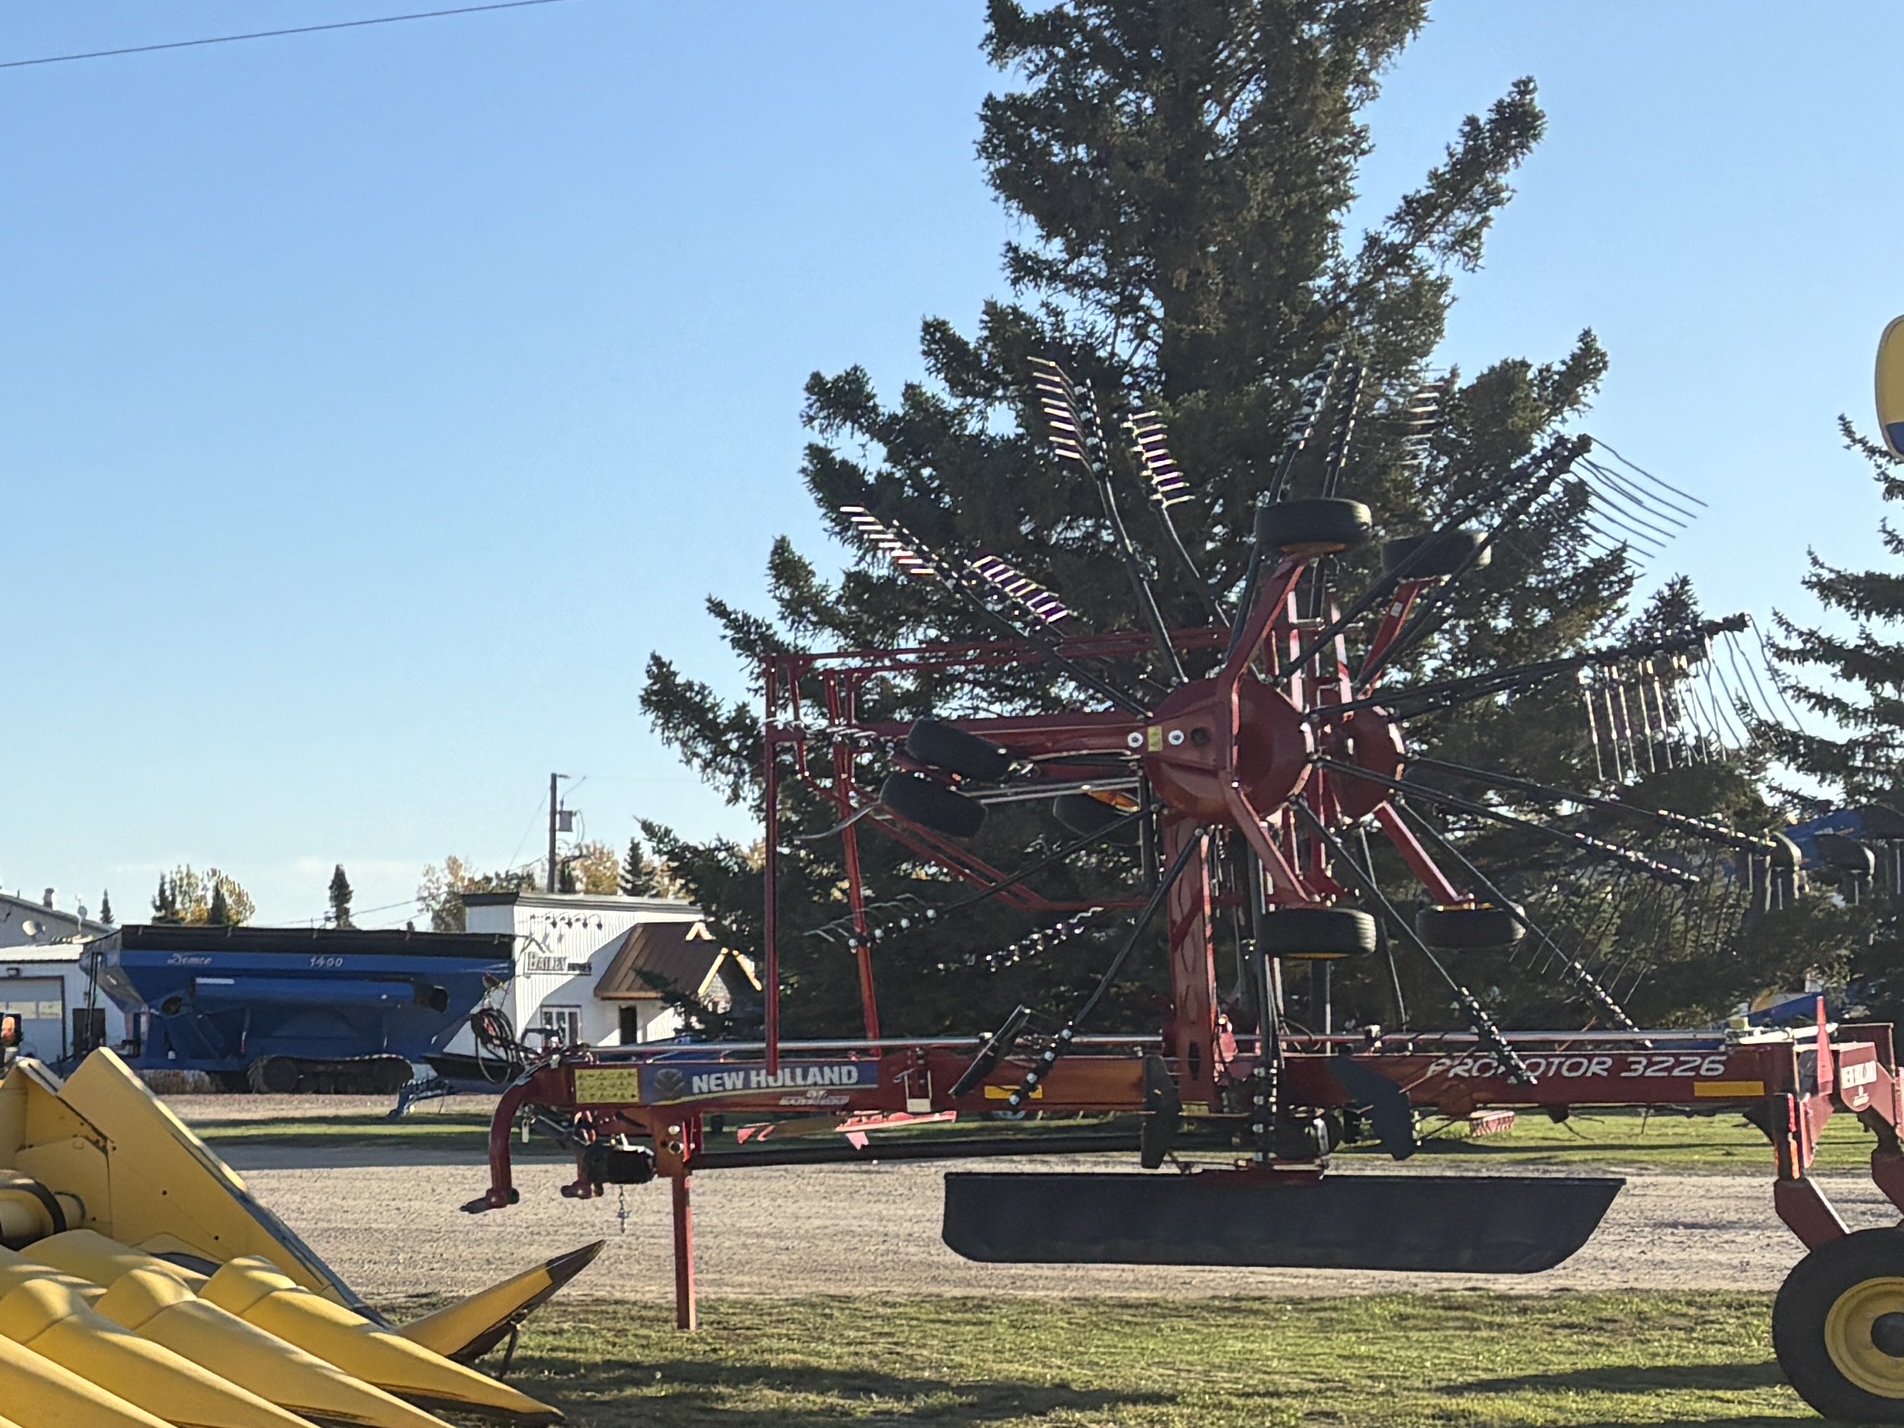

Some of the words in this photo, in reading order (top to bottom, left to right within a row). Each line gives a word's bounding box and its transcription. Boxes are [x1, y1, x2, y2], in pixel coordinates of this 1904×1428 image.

[692, 1071, 743, 1095] NEW
[749, 1065, 859, 1089] HOLLAND
[1426, 1056, 1613, 1079] PROOTOR
[1619, 1055, 1729, 1078] 3226
